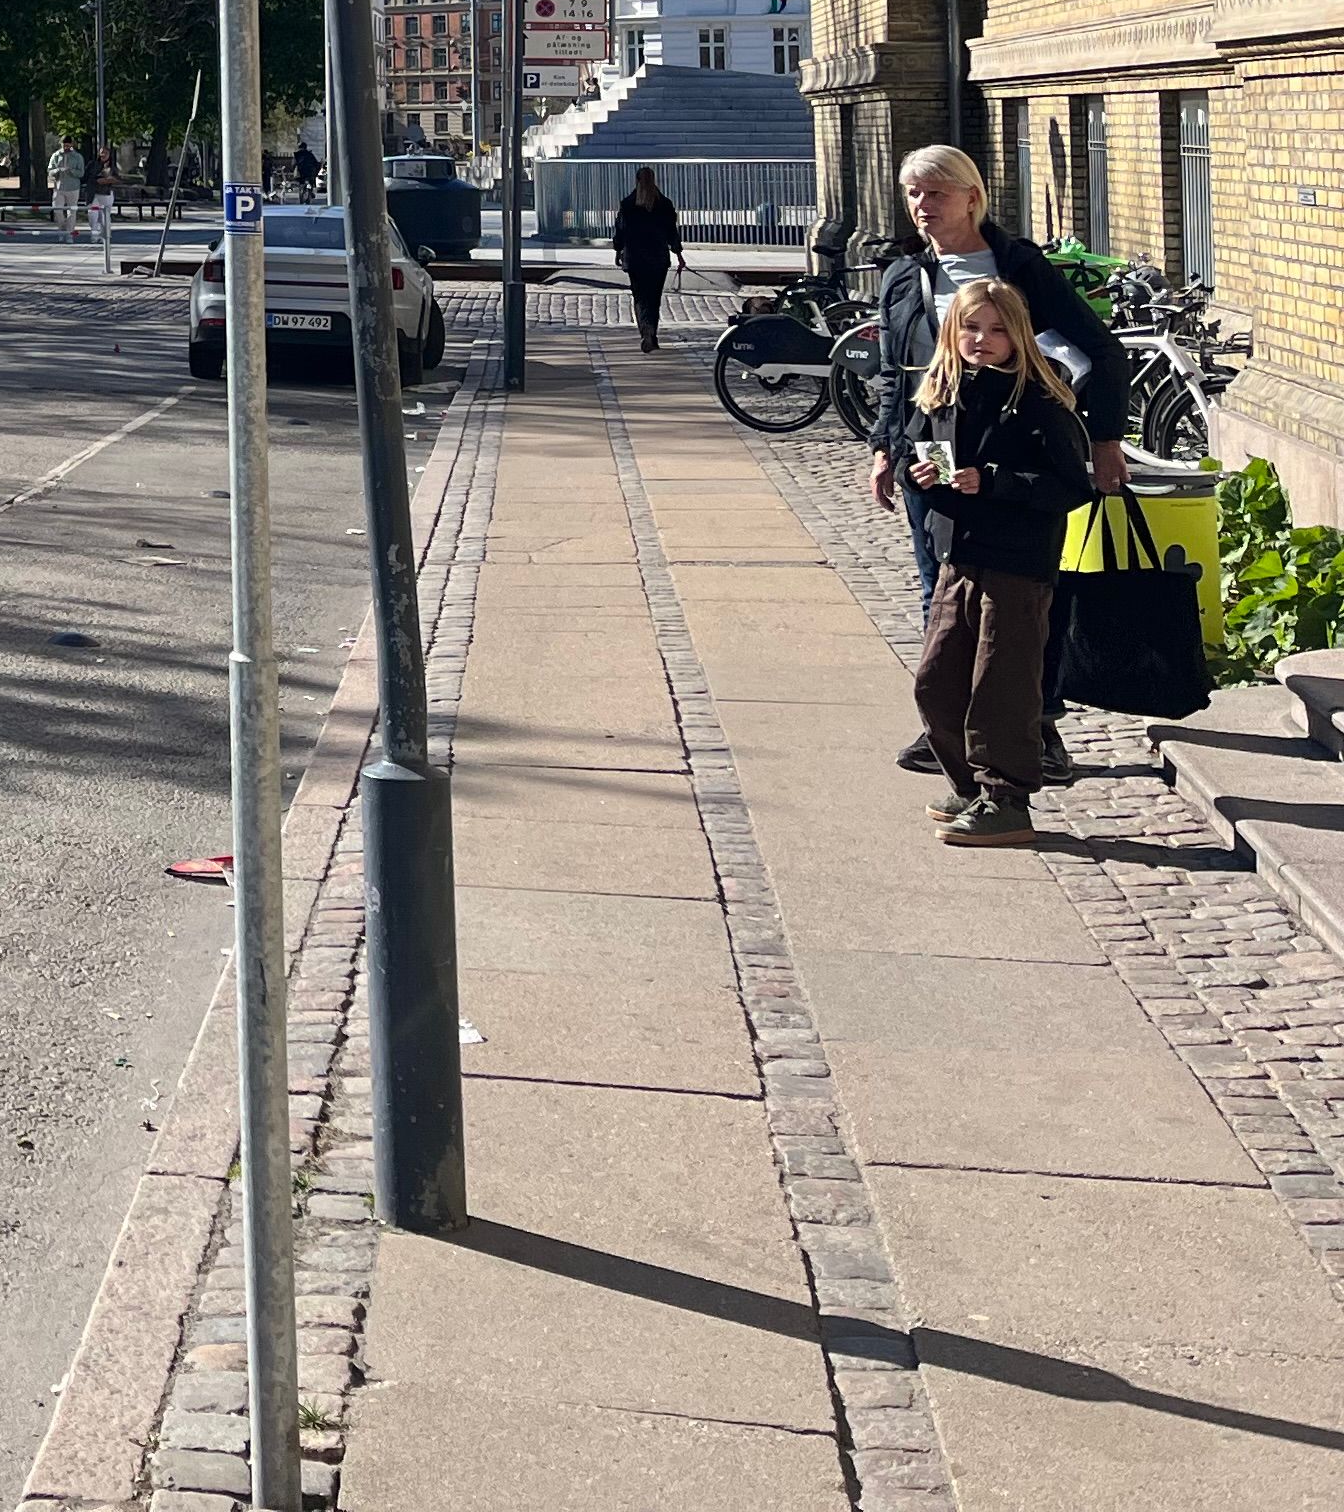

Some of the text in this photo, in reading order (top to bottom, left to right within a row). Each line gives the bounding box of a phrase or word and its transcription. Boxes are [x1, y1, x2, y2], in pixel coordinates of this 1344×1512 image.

[526, 74, 538, 88] P
[235, 195, 255, 220] P
[291, 316, 306, 326] 97
[308, 317, 329, 328] 492
